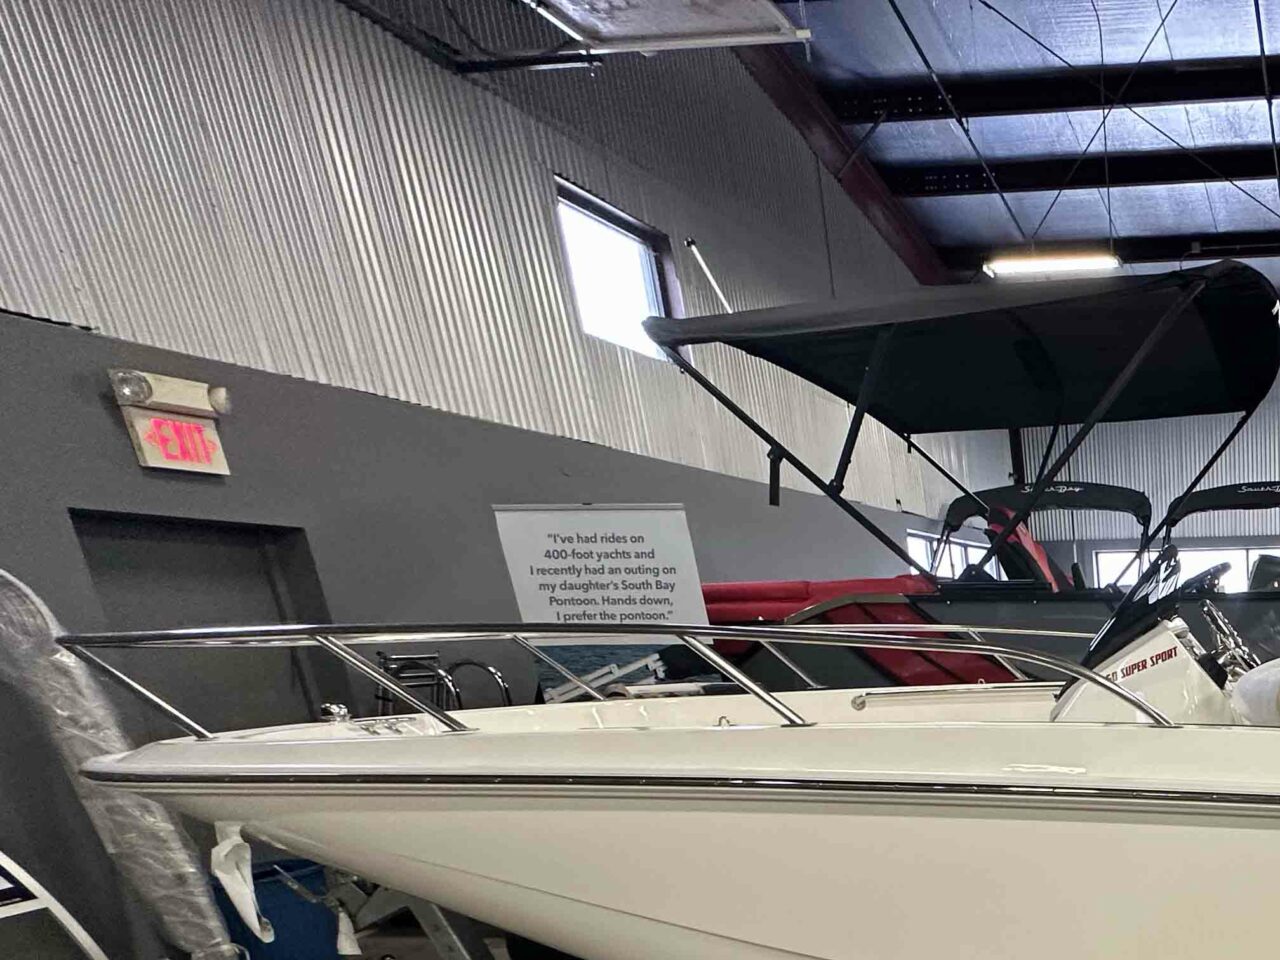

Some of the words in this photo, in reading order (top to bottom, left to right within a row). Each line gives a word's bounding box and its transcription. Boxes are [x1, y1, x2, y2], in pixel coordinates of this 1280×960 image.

[150, 416, 213, 465] EXIT
[547, 533, 574, 544] "I've
[576, 533, 598, 544] had
[600, 533, 628, 544] rides
[630, 535, 645, 544] on
[544, 549, 594, 560] 400-foot
[596, 549, 632, 562] yachts
[633, 549, 655, 559] and
[530, 565, 534, 576] I
[536, 565, 582, 577] recently
[584, 565, 605, 575] had
[607, 567, 622, 575] an
[624, 565, 660, 577] outing
[662, 567, 677, 575] on
[539, 582, 557, 593] my
[559, 580, 619, 593] daughter's
[621, 580, 653, 590] South
[655, 581, 676, 592] Bay
[549, 596, 600, 606] Pontoon.
[601, 595, 637, 605] Hands
[639, 595, 674, 607] down,
[563, 611, 598, 623] prefer
[599, 610, 617, 621] the
[619, 610, 674, 623] pontoon."
[1120, 658, 1148, 679] SUPER
[1149, 646, 1178, 667] SPORT
